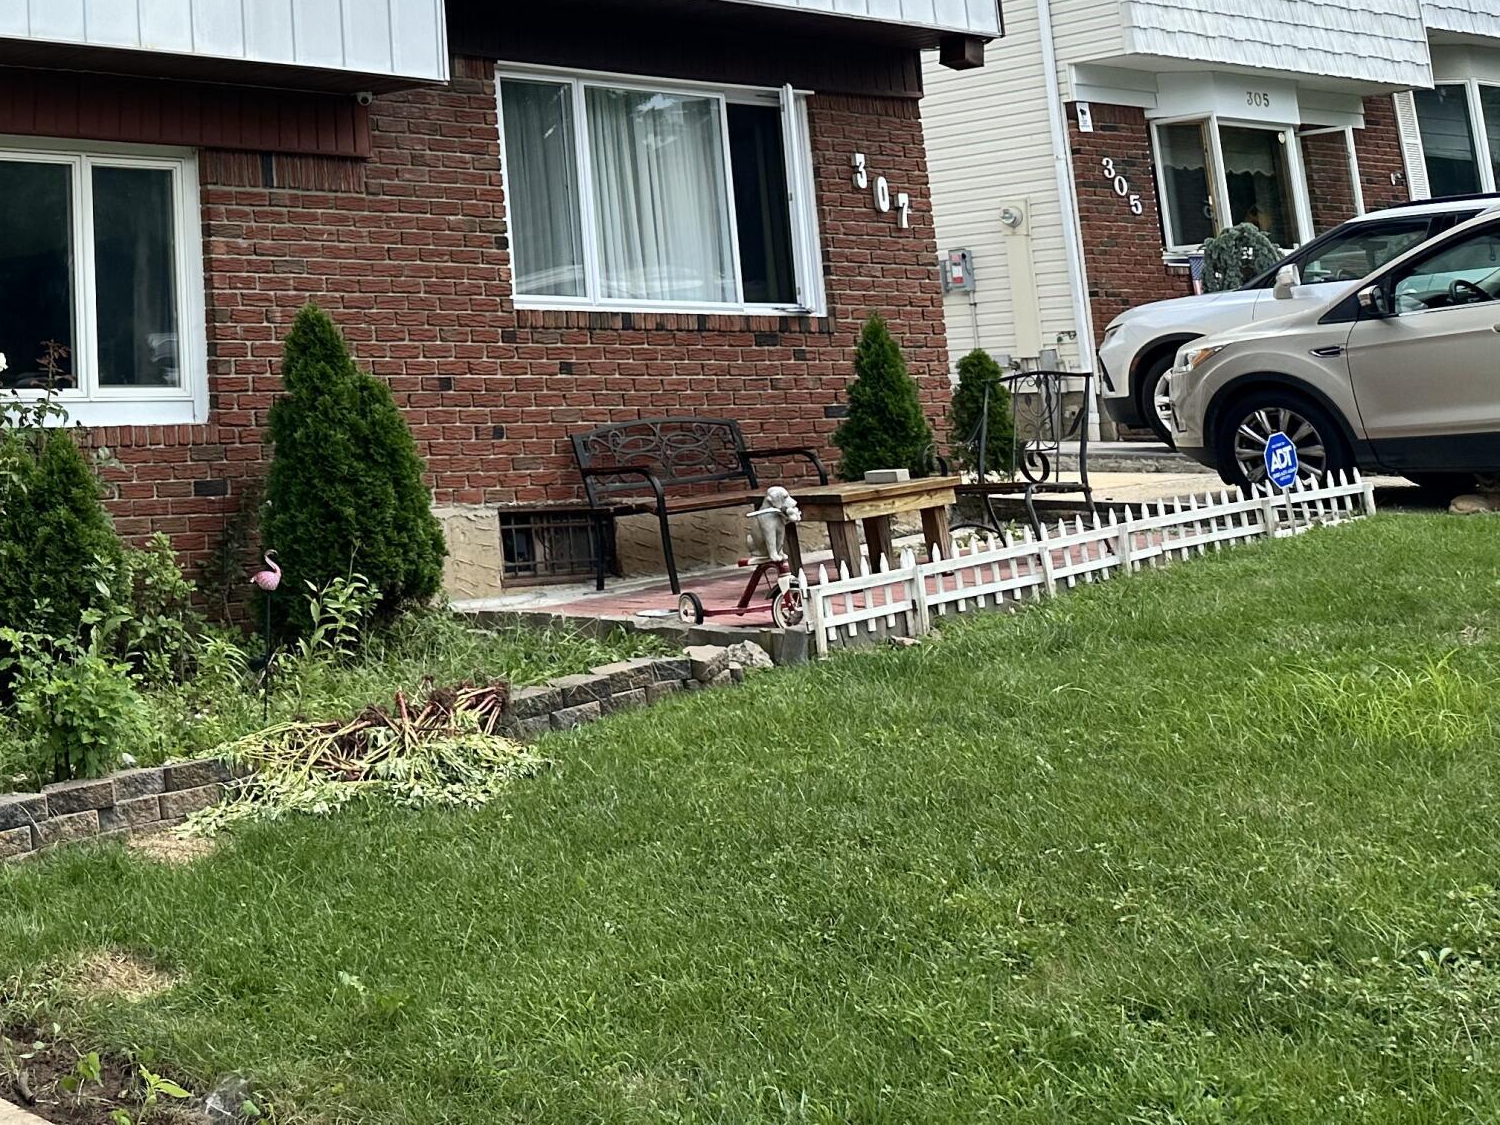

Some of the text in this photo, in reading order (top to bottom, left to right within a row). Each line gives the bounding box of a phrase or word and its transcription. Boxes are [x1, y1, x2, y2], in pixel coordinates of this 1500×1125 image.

[1246, 91, 1270, 108] 305
[851, 153, 909, 228] 307
[1101, 157, 1143, 215] 305
[1271, 445, 1293, 472] ADT
